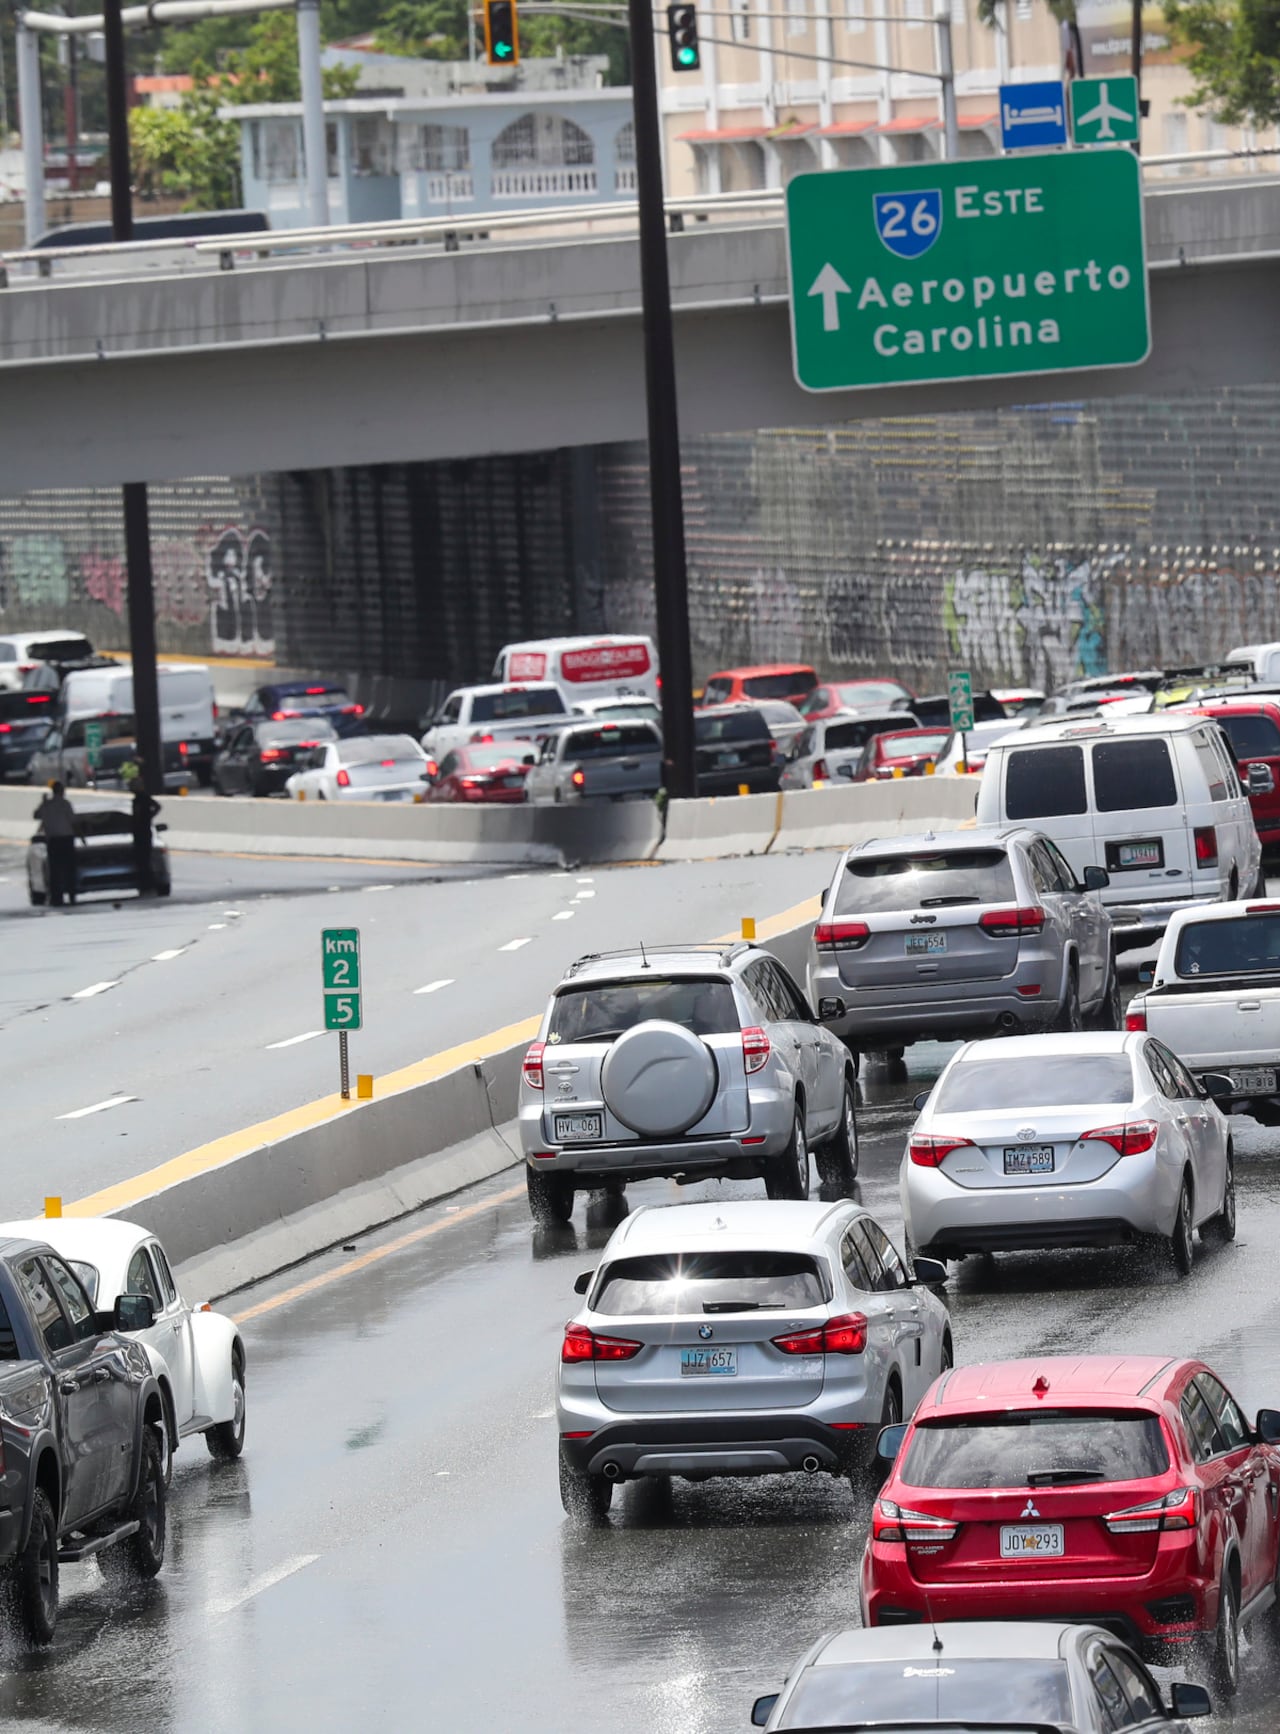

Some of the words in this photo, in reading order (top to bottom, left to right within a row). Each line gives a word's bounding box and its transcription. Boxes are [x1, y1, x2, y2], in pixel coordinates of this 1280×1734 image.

[954, 185, 1045, 219] ESTE
[880, 199, 937, 238] 26
[857, 259, 1131, 309] Aeropuerto
[872, 315, 1061, 357] Carolina
[325, 937, 355, 954] km
[927, 936, 944, 947] 554
[332, 959, 350, 985] 2
[558, 1120, 577, 1133] HVL
[581, 1119, 599, 1131] 061
[1007, 1153, 1025, 1167] IMZ
[1032, 1152, 1050, 1165] 589
[684, 1353, 705, 1368] JJZ
[711, 1352, 732, 1367] 657
[1004, 1534, 1027, 1551] JOY
[1036, 1533, 1059, 1550] 293
